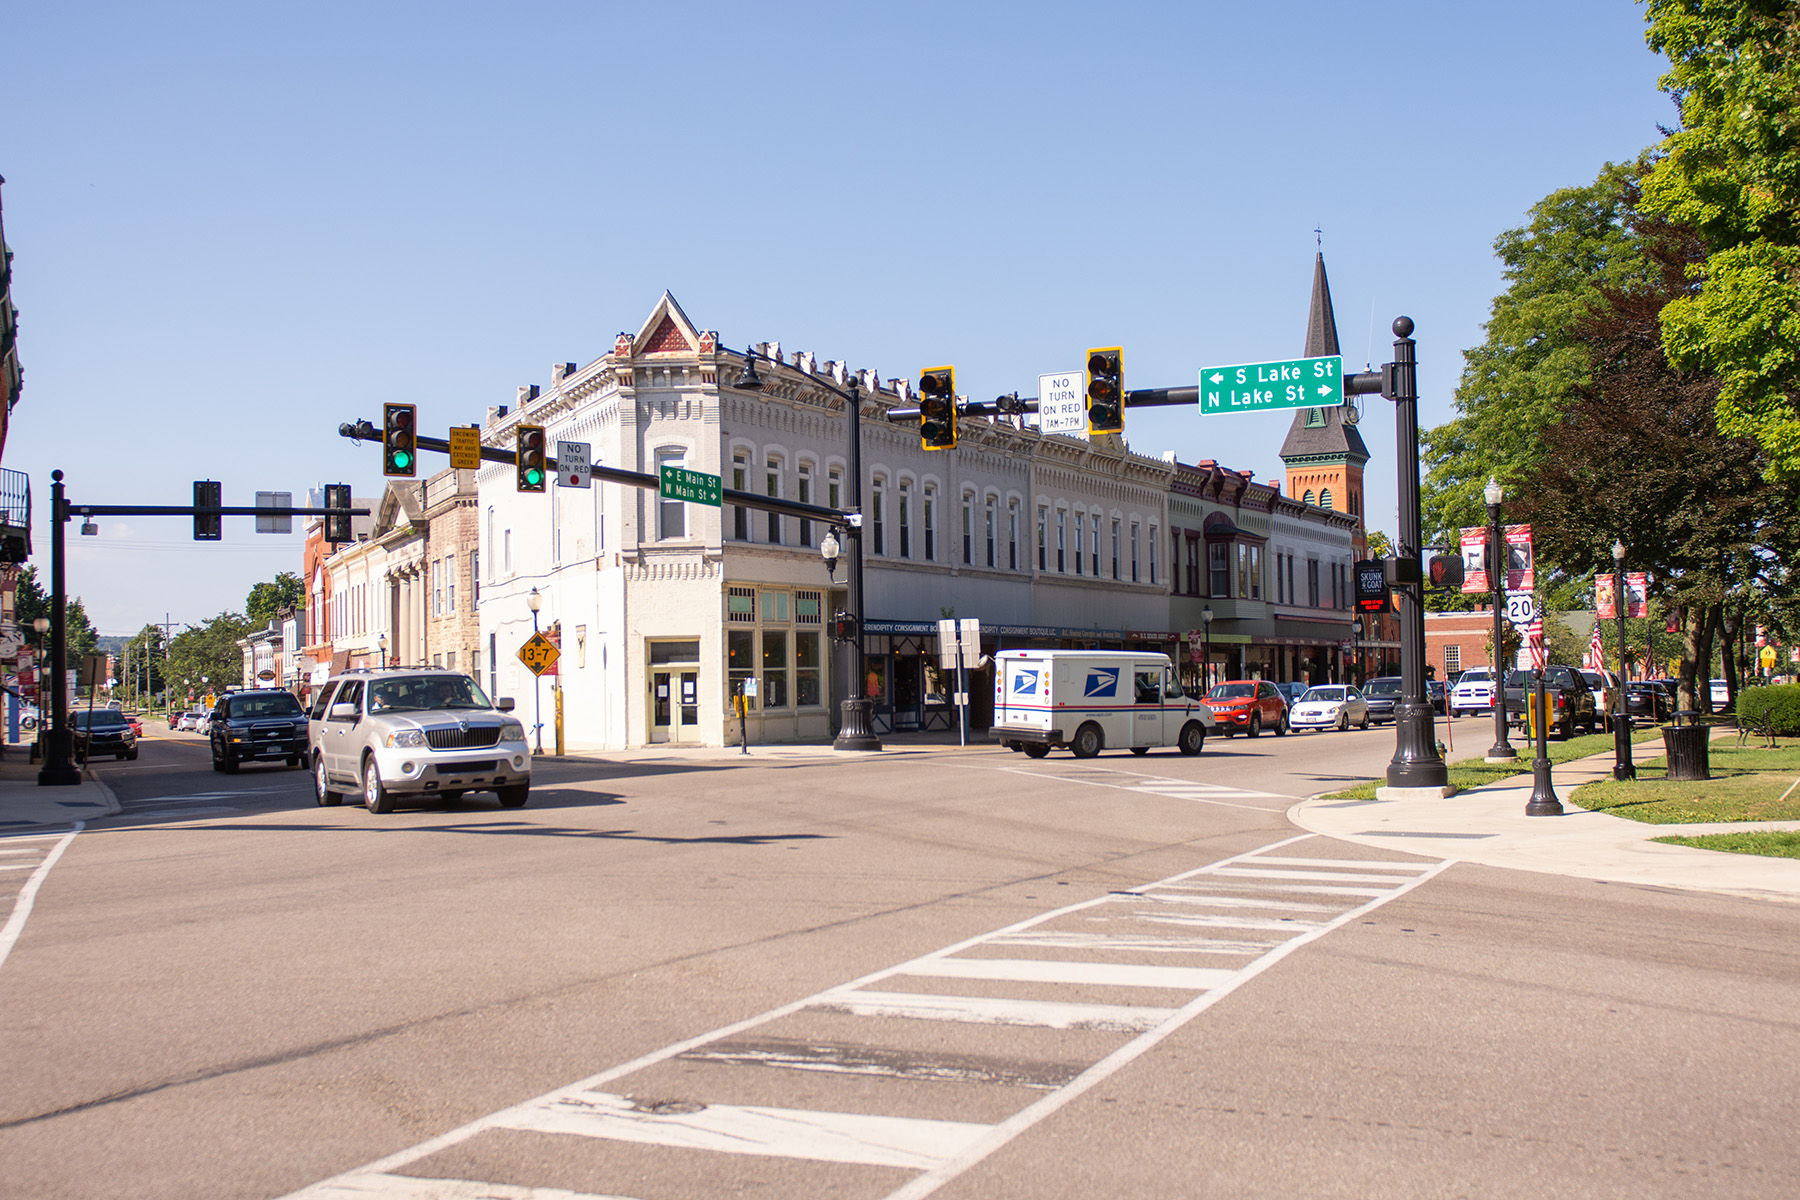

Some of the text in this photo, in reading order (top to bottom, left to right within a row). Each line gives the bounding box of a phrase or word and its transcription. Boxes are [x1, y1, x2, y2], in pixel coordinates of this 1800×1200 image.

[1236, 361, 1333, 384] S Lake St
[1053, 378, 1070, 388] NO
[1049, 390, 1075, 402] TURN
[1208, 385, 1304, 408] N Lake St
[1043, 402, 1080, 416] ON RED
[1046, 417, 1080, 428] 7AM-7PM
[567, 444, 582, 454] NO
[564, 454, 585, 463] TURN
[560, 464, 590, 474] ON RED
[676, 470, 716, 488] E Main St
[665, 482, 707, 500] W Main St
[1360, 572, 1382, 581] SKUNK
[1366, 580, 1382, 588] GOAT
[1510, 600, 1530, 617] 20
[894, 624, 928, 632] CONSIGNMENT
